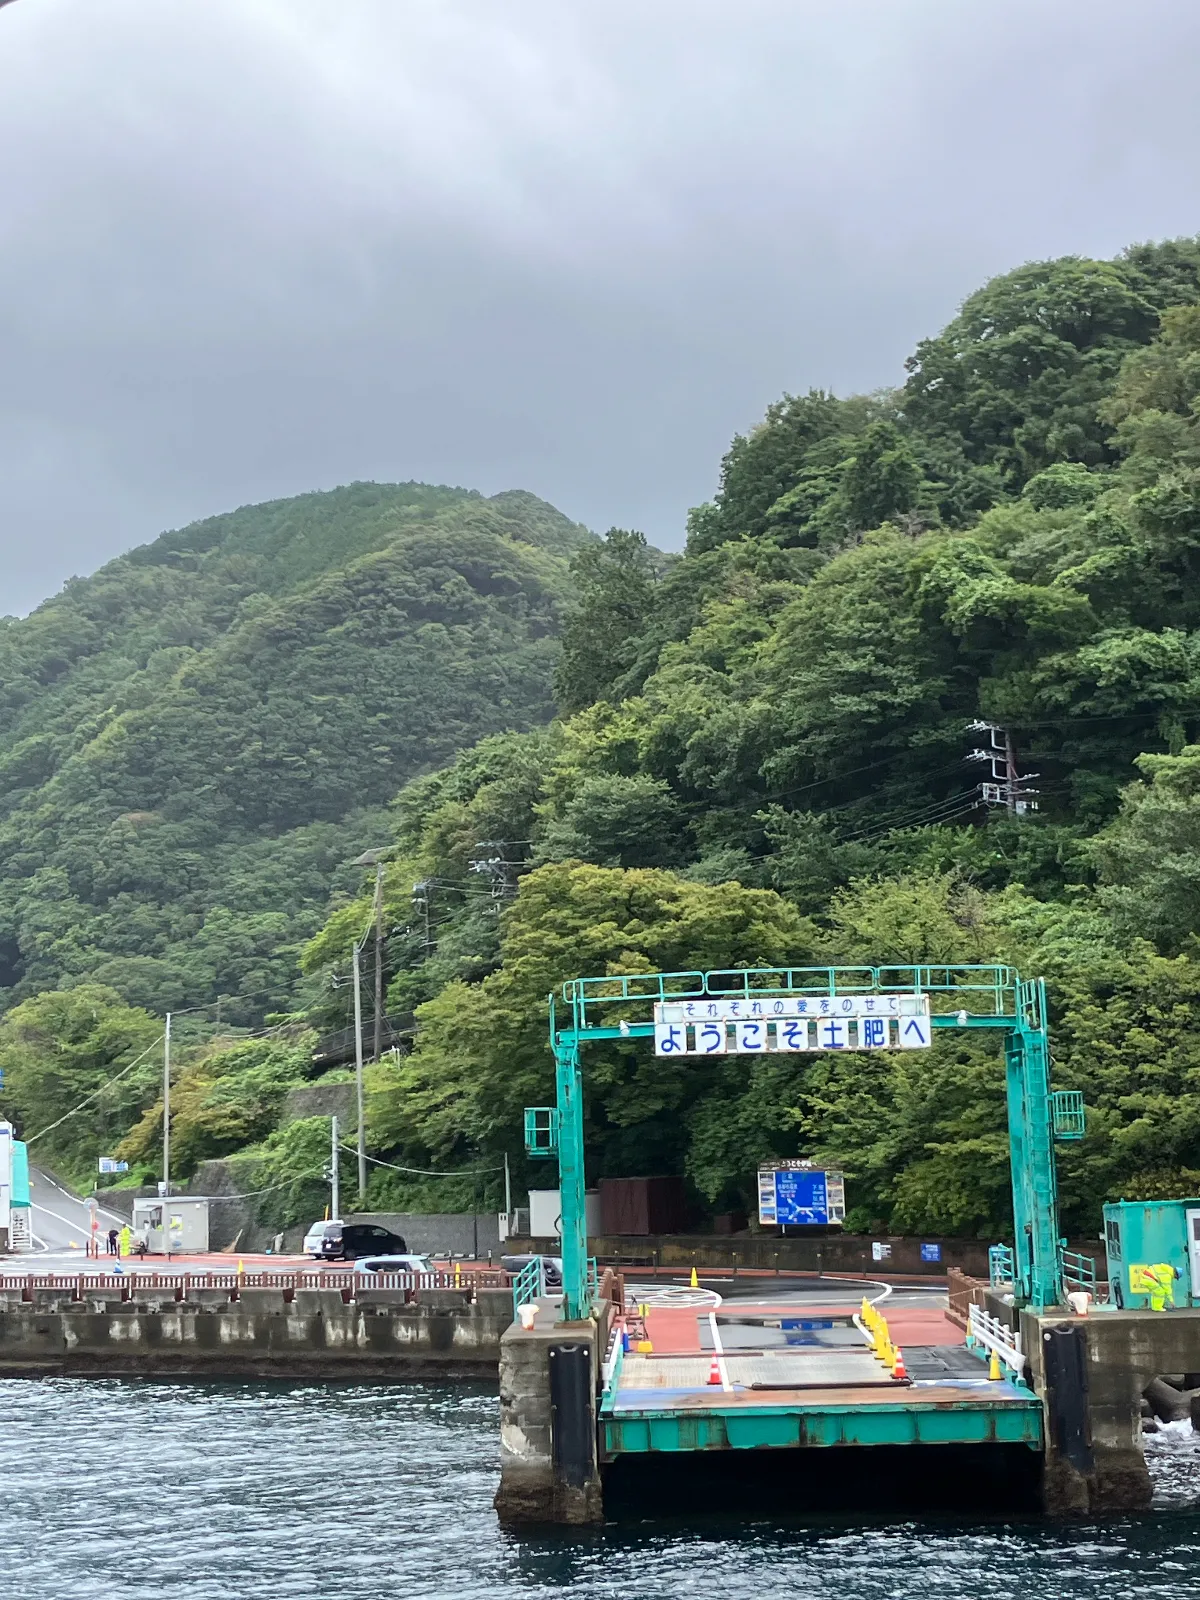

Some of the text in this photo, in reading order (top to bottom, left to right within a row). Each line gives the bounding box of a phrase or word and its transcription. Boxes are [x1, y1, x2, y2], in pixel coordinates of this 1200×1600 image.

[685, 997, 897, 1016] それぞれの愛をのせて
[661, 1019, 925, 1052] ようこそ土肥へ
